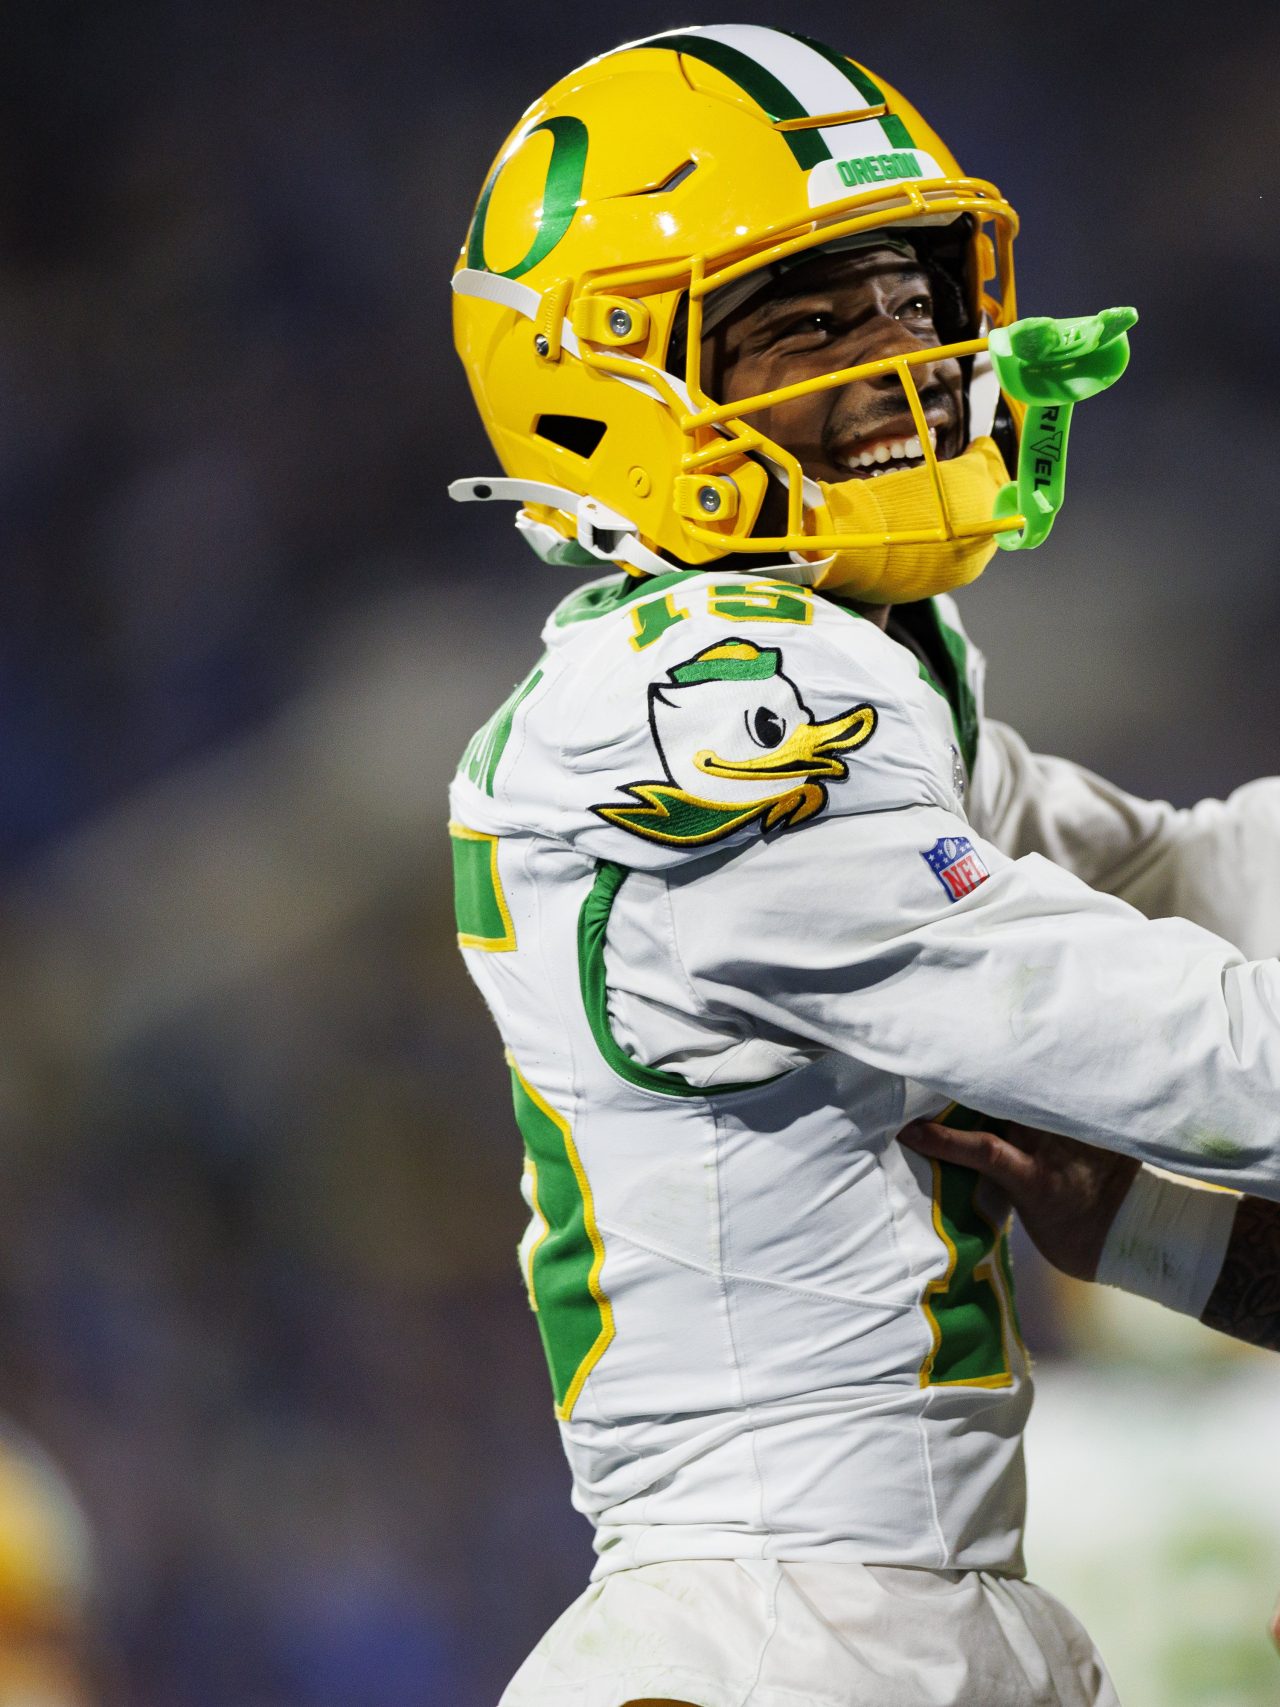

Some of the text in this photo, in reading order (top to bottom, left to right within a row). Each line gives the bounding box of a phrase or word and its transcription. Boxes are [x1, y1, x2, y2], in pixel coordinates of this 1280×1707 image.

[836, 152, 923, 187] OREGON
[628, 580, 815, 652] 15
[942, 854, 989, 898] NFL
